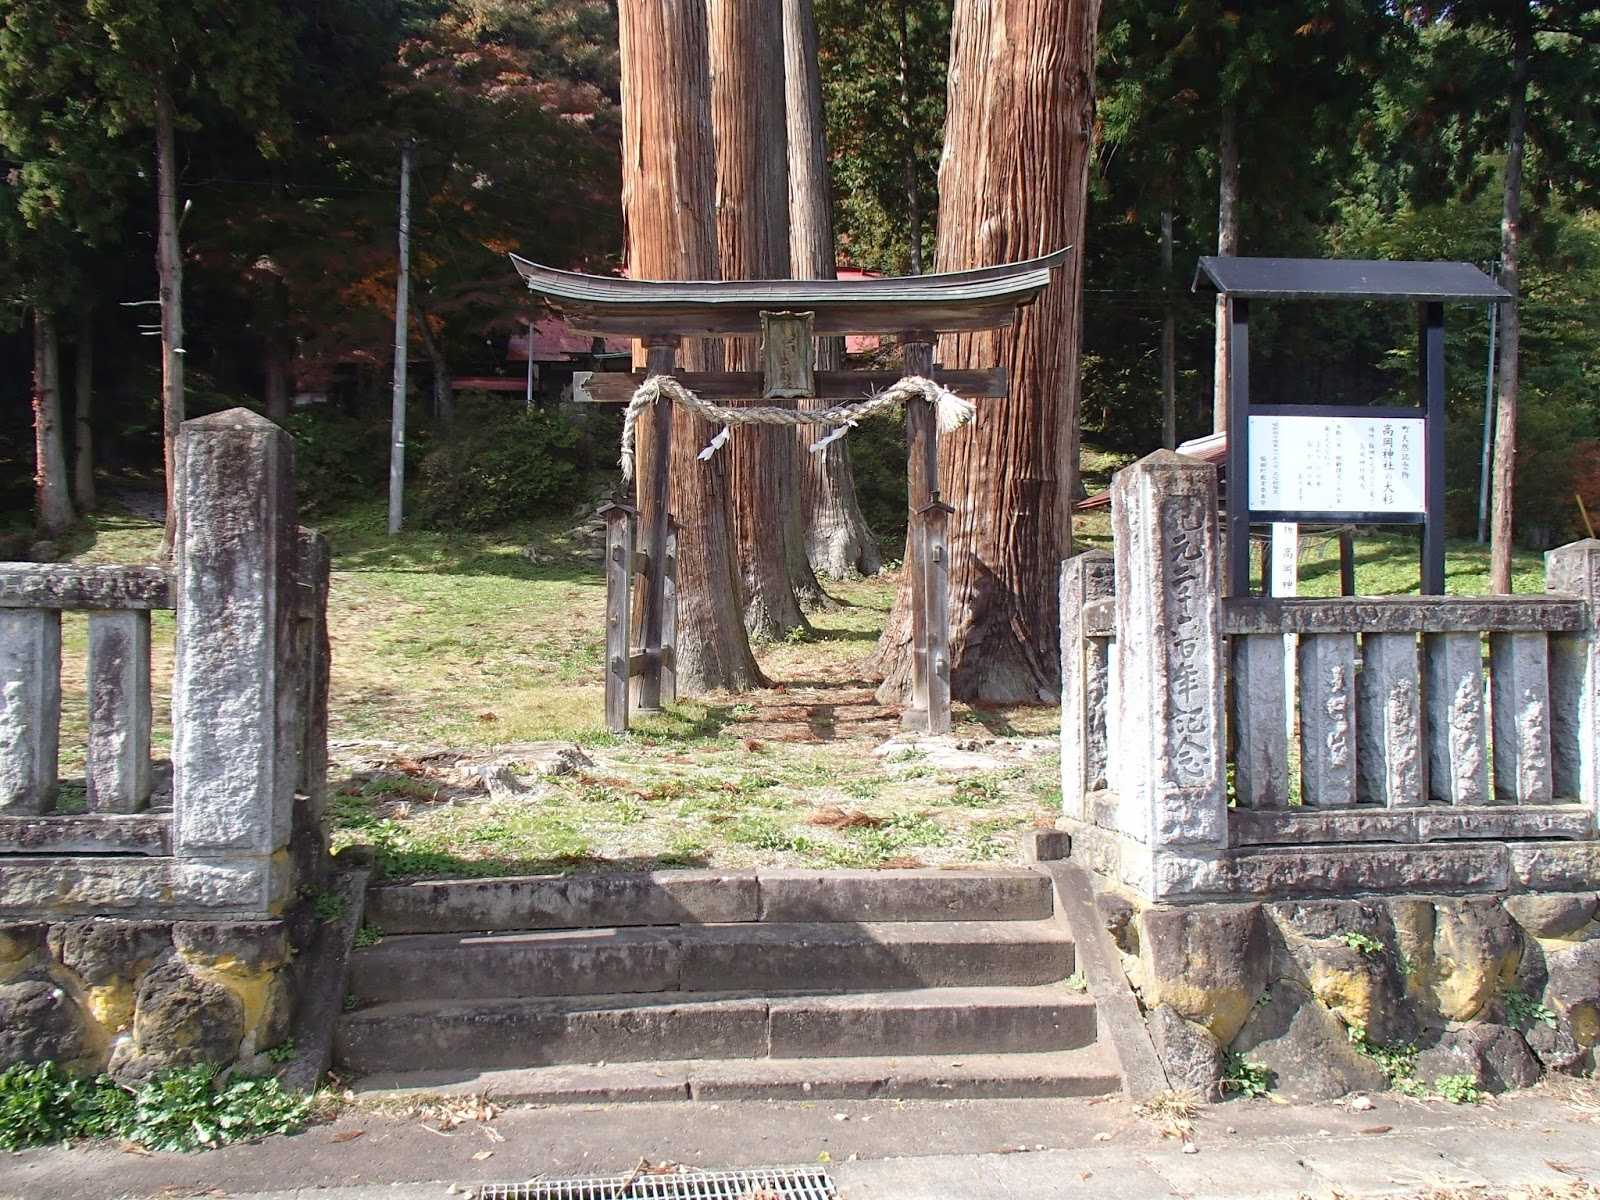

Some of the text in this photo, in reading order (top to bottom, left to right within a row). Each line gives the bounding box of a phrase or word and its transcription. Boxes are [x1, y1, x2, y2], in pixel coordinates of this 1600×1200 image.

[1383, 424, 1395, 505] 高岡神社の大杉
